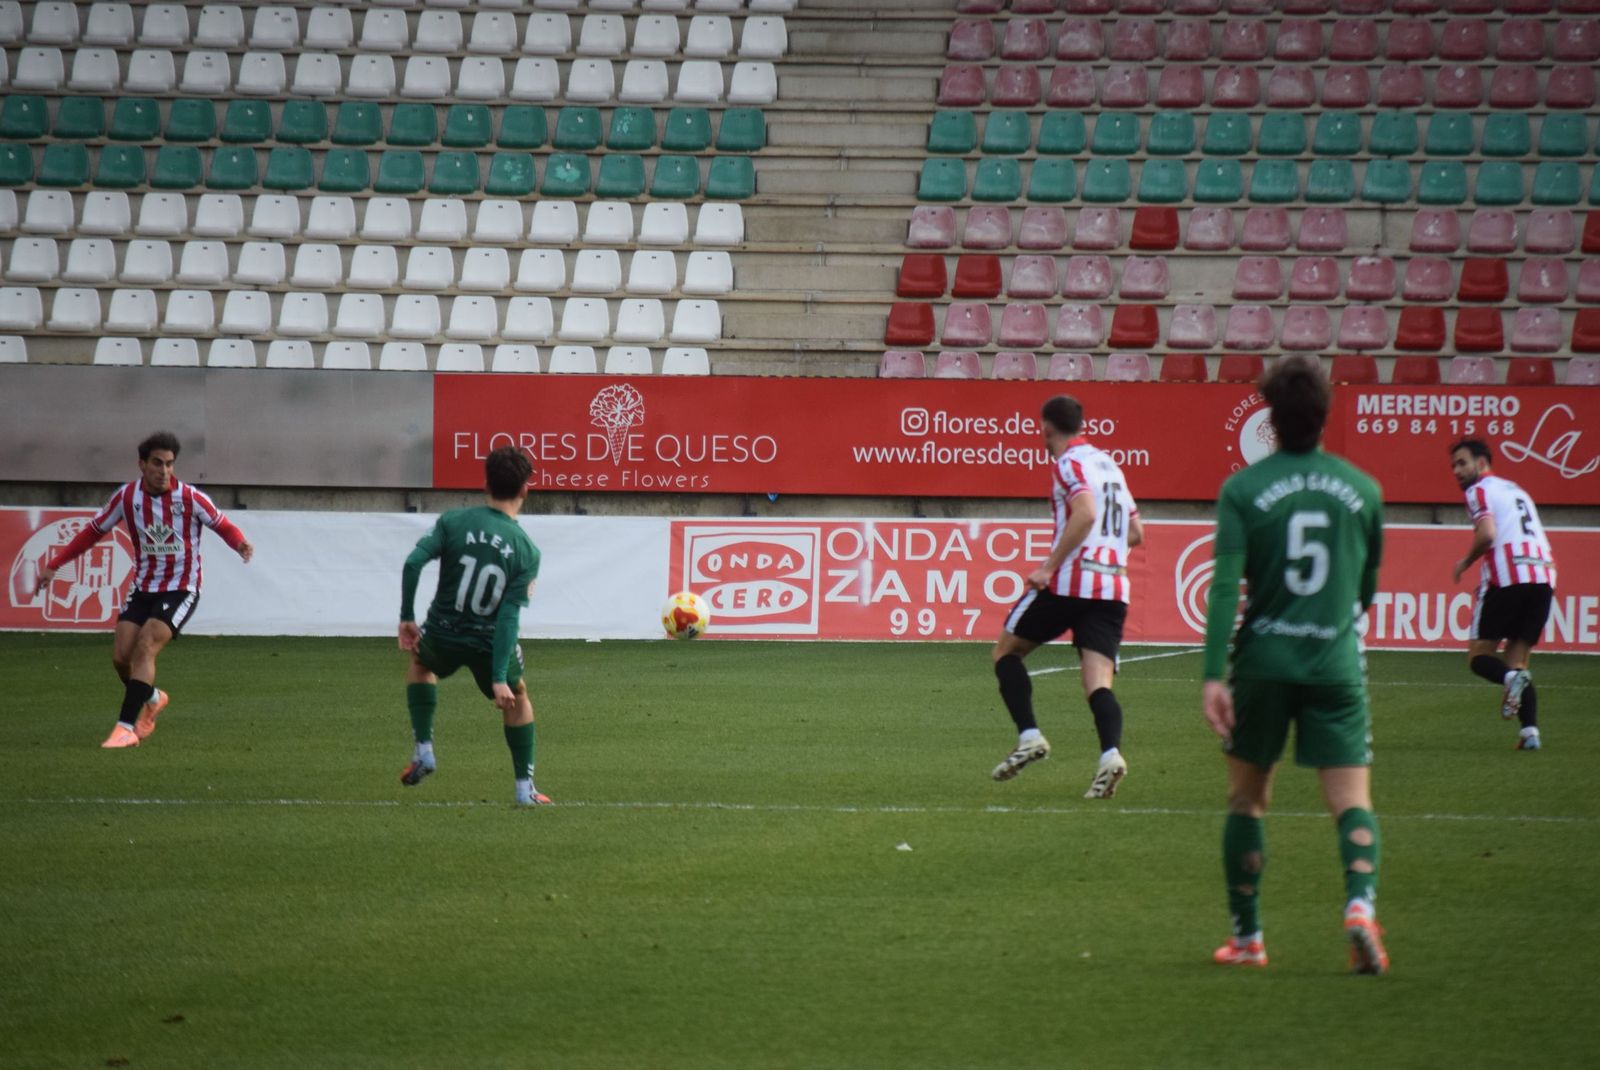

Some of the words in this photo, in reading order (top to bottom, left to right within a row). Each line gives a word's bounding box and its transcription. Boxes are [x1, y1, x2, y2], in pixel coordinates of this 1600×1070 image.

[1356, 394, 1521, 417] MERENDERO
[933, 410, 1115, 436] flores.de.eso
[1356, 418, 1400, 435] 669
[1409, 419, 1437, 435] 84
[1449, 420, 1476, 436] 15
[1487, 420, 1515, 436] 68
[453, 432, 577, 461] FLORES
[586, 433, 645, 462] DE
[655, 434, 777, 467] QUESO
[852, 441, 1150, 470] www.floresdequom
[1500, 403, 1600, 479] La
[621, 470, 710, 488] Flowers
[1101, 482, 1123, 538] 16
[1516, 498, 1535, 537] 2
[465, 530, 515, 559] ALEX
[826, 527, 973, 561] ONDA
[986, 528, 1055, 562] CE
[1284, 510, 1331, 596] 5
[707, 553, 794, 572] ONDA
[455, 554, 507, 617] 10
[711, 588, 794, 609] CERO
[824, 569, 1025, 604] ZAMO
